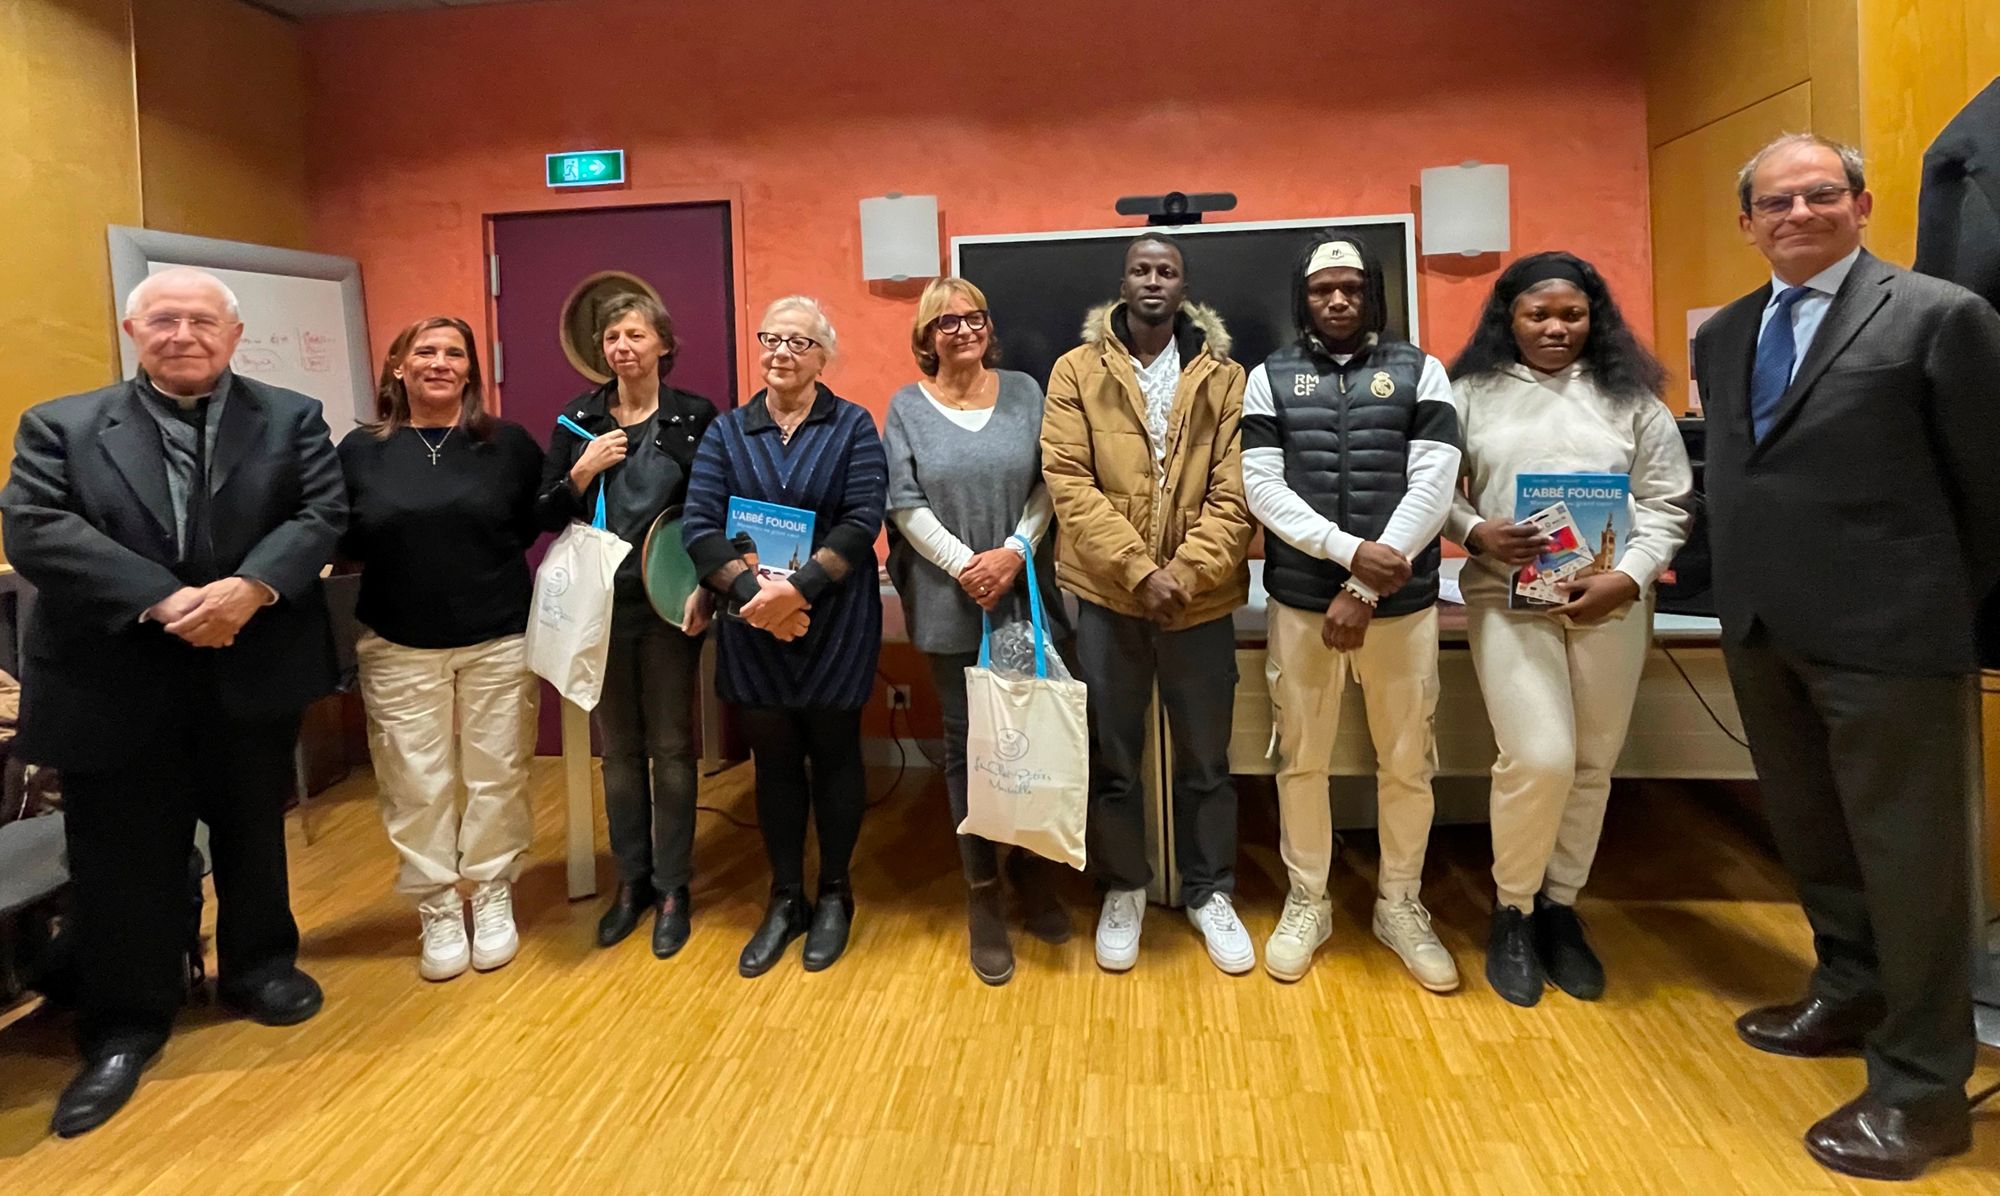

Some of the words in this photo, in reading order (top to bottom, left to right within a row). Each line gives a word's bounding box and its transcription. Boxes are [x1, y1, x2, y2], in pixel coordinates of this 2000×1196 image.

[1295, 373, 1320, 385] RM
[1293, 383, 1316, 396] CF
[1523, 485, 1564, 498] L'ABBÉ
[1567, 487, 1623, 499] FOUQUE
[732, 509, 764, 525] L'ABBÉ
[765, 516, 808, 533] FOUQUE
